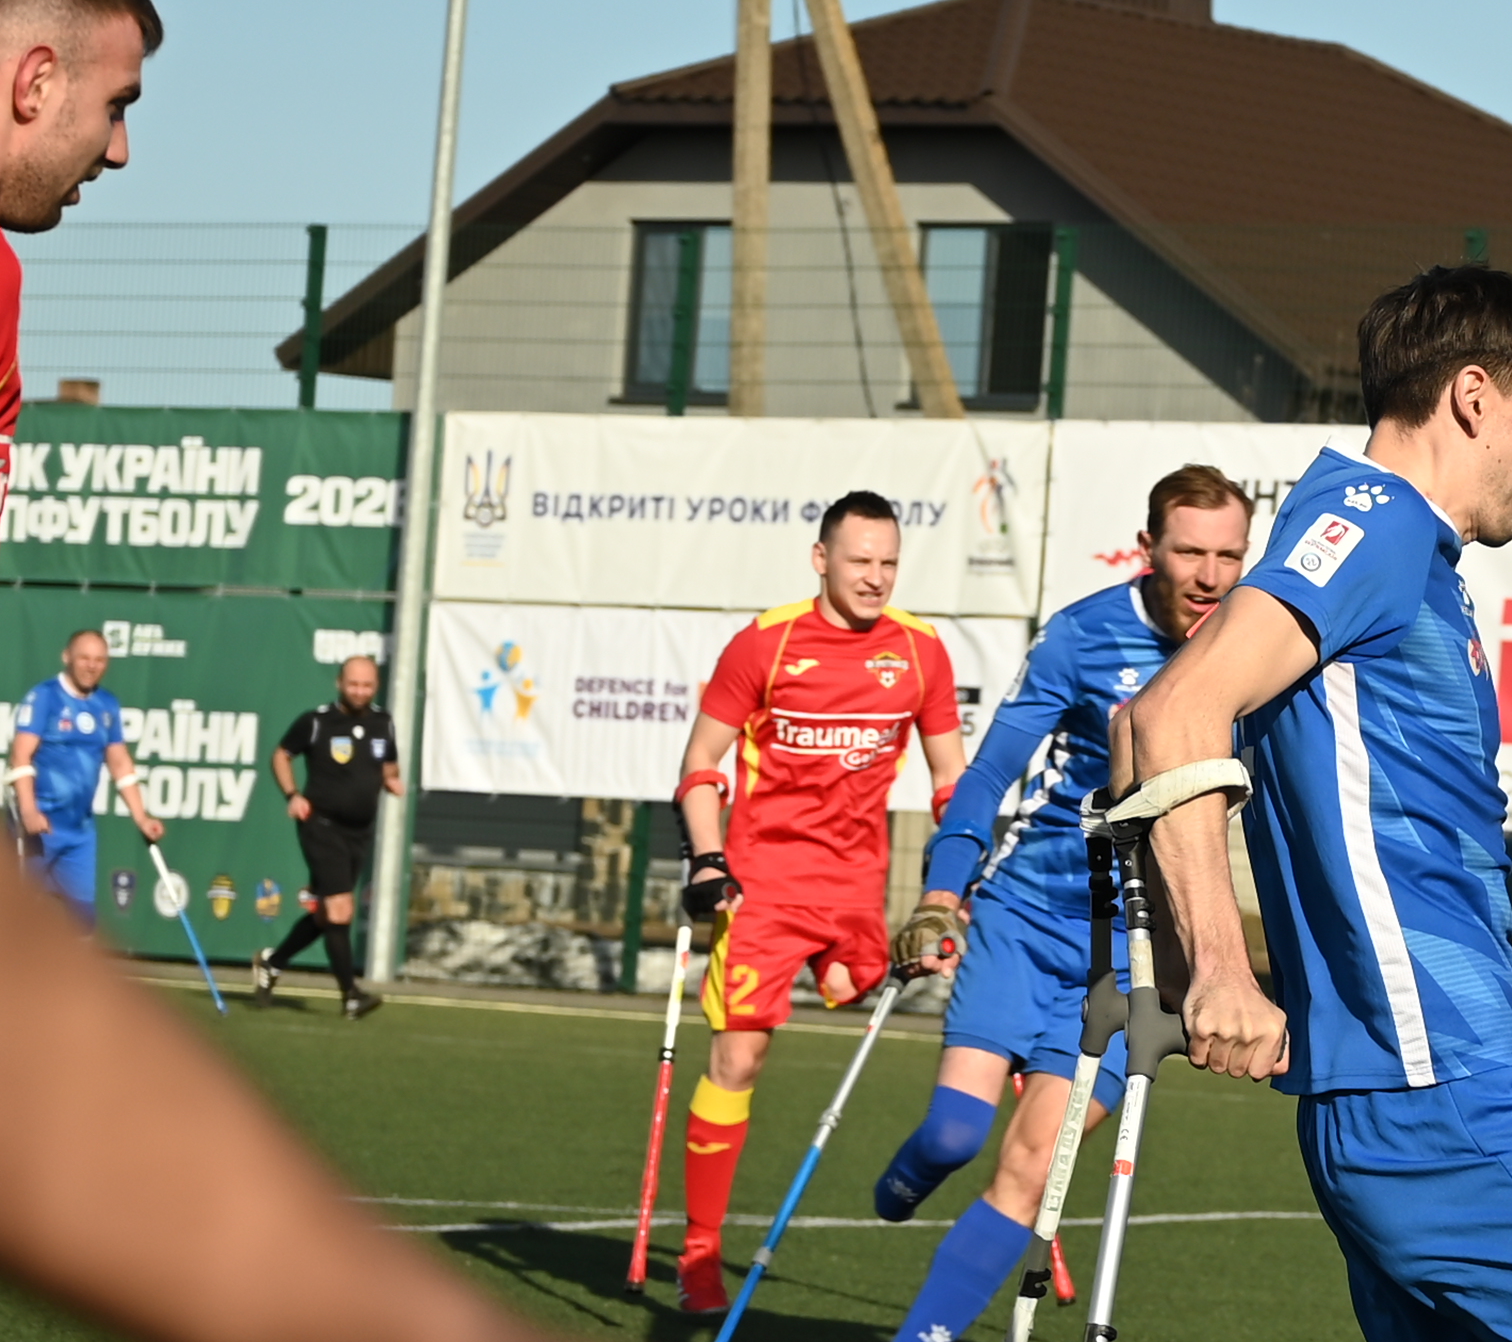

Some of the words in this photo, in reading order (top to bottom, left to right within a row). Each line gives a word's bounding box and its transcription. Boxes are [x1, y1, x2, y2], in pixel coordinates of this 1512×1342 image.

[57, 435, 263, 496] УКРАЇНИ
[531, 491, 676, 524] ВІДКРИТІ
[685, 496, 791, 525] УРОКИ
[574, 676, 654, 696] DEFENCE
[572, 699, 688, 721] CHILDREN
[729, 963, 759, 1016] 2
